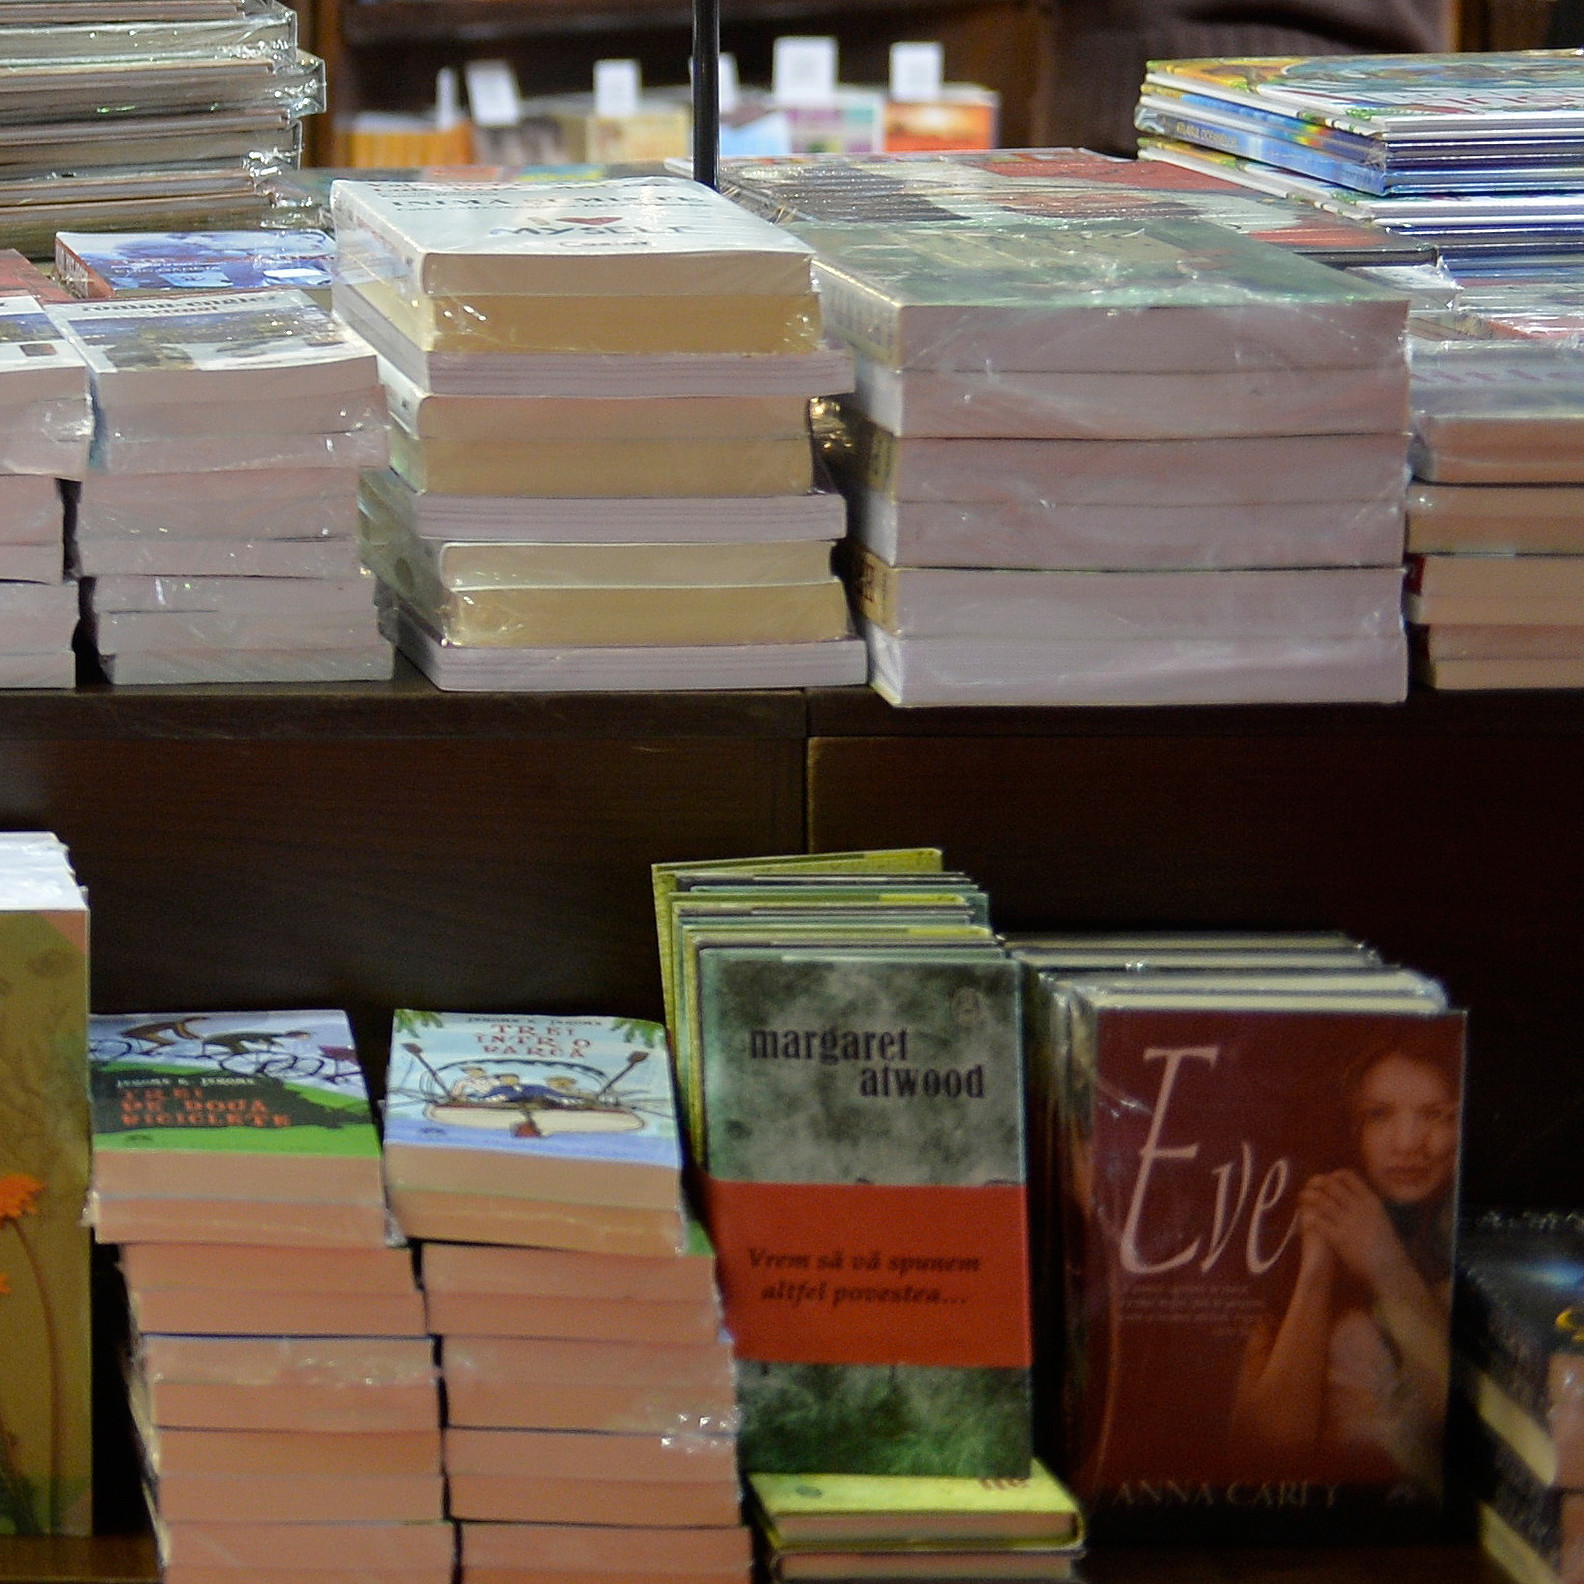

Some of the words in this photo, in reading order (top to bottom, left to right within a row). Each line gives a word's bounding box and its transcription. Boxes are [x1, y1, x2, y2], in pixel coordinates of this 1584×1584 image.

[491, 1023, 574, 1037] TREI
[748, 1024, 909, 1065] margaret
[859, 1063, 985, 1098] atwood
[1120, 1045, 1306, 1276] Eve
[747, 1248, 811, 1271] Vrem
[817, 1250, 845, 1271] să
[851, 1250, 881, 1271] vă
[887, 1252, 980, 1277] spunem
[761, 1280, 826, 1308] altfel
[1112, 1480, 1215, 1507] ANNA
